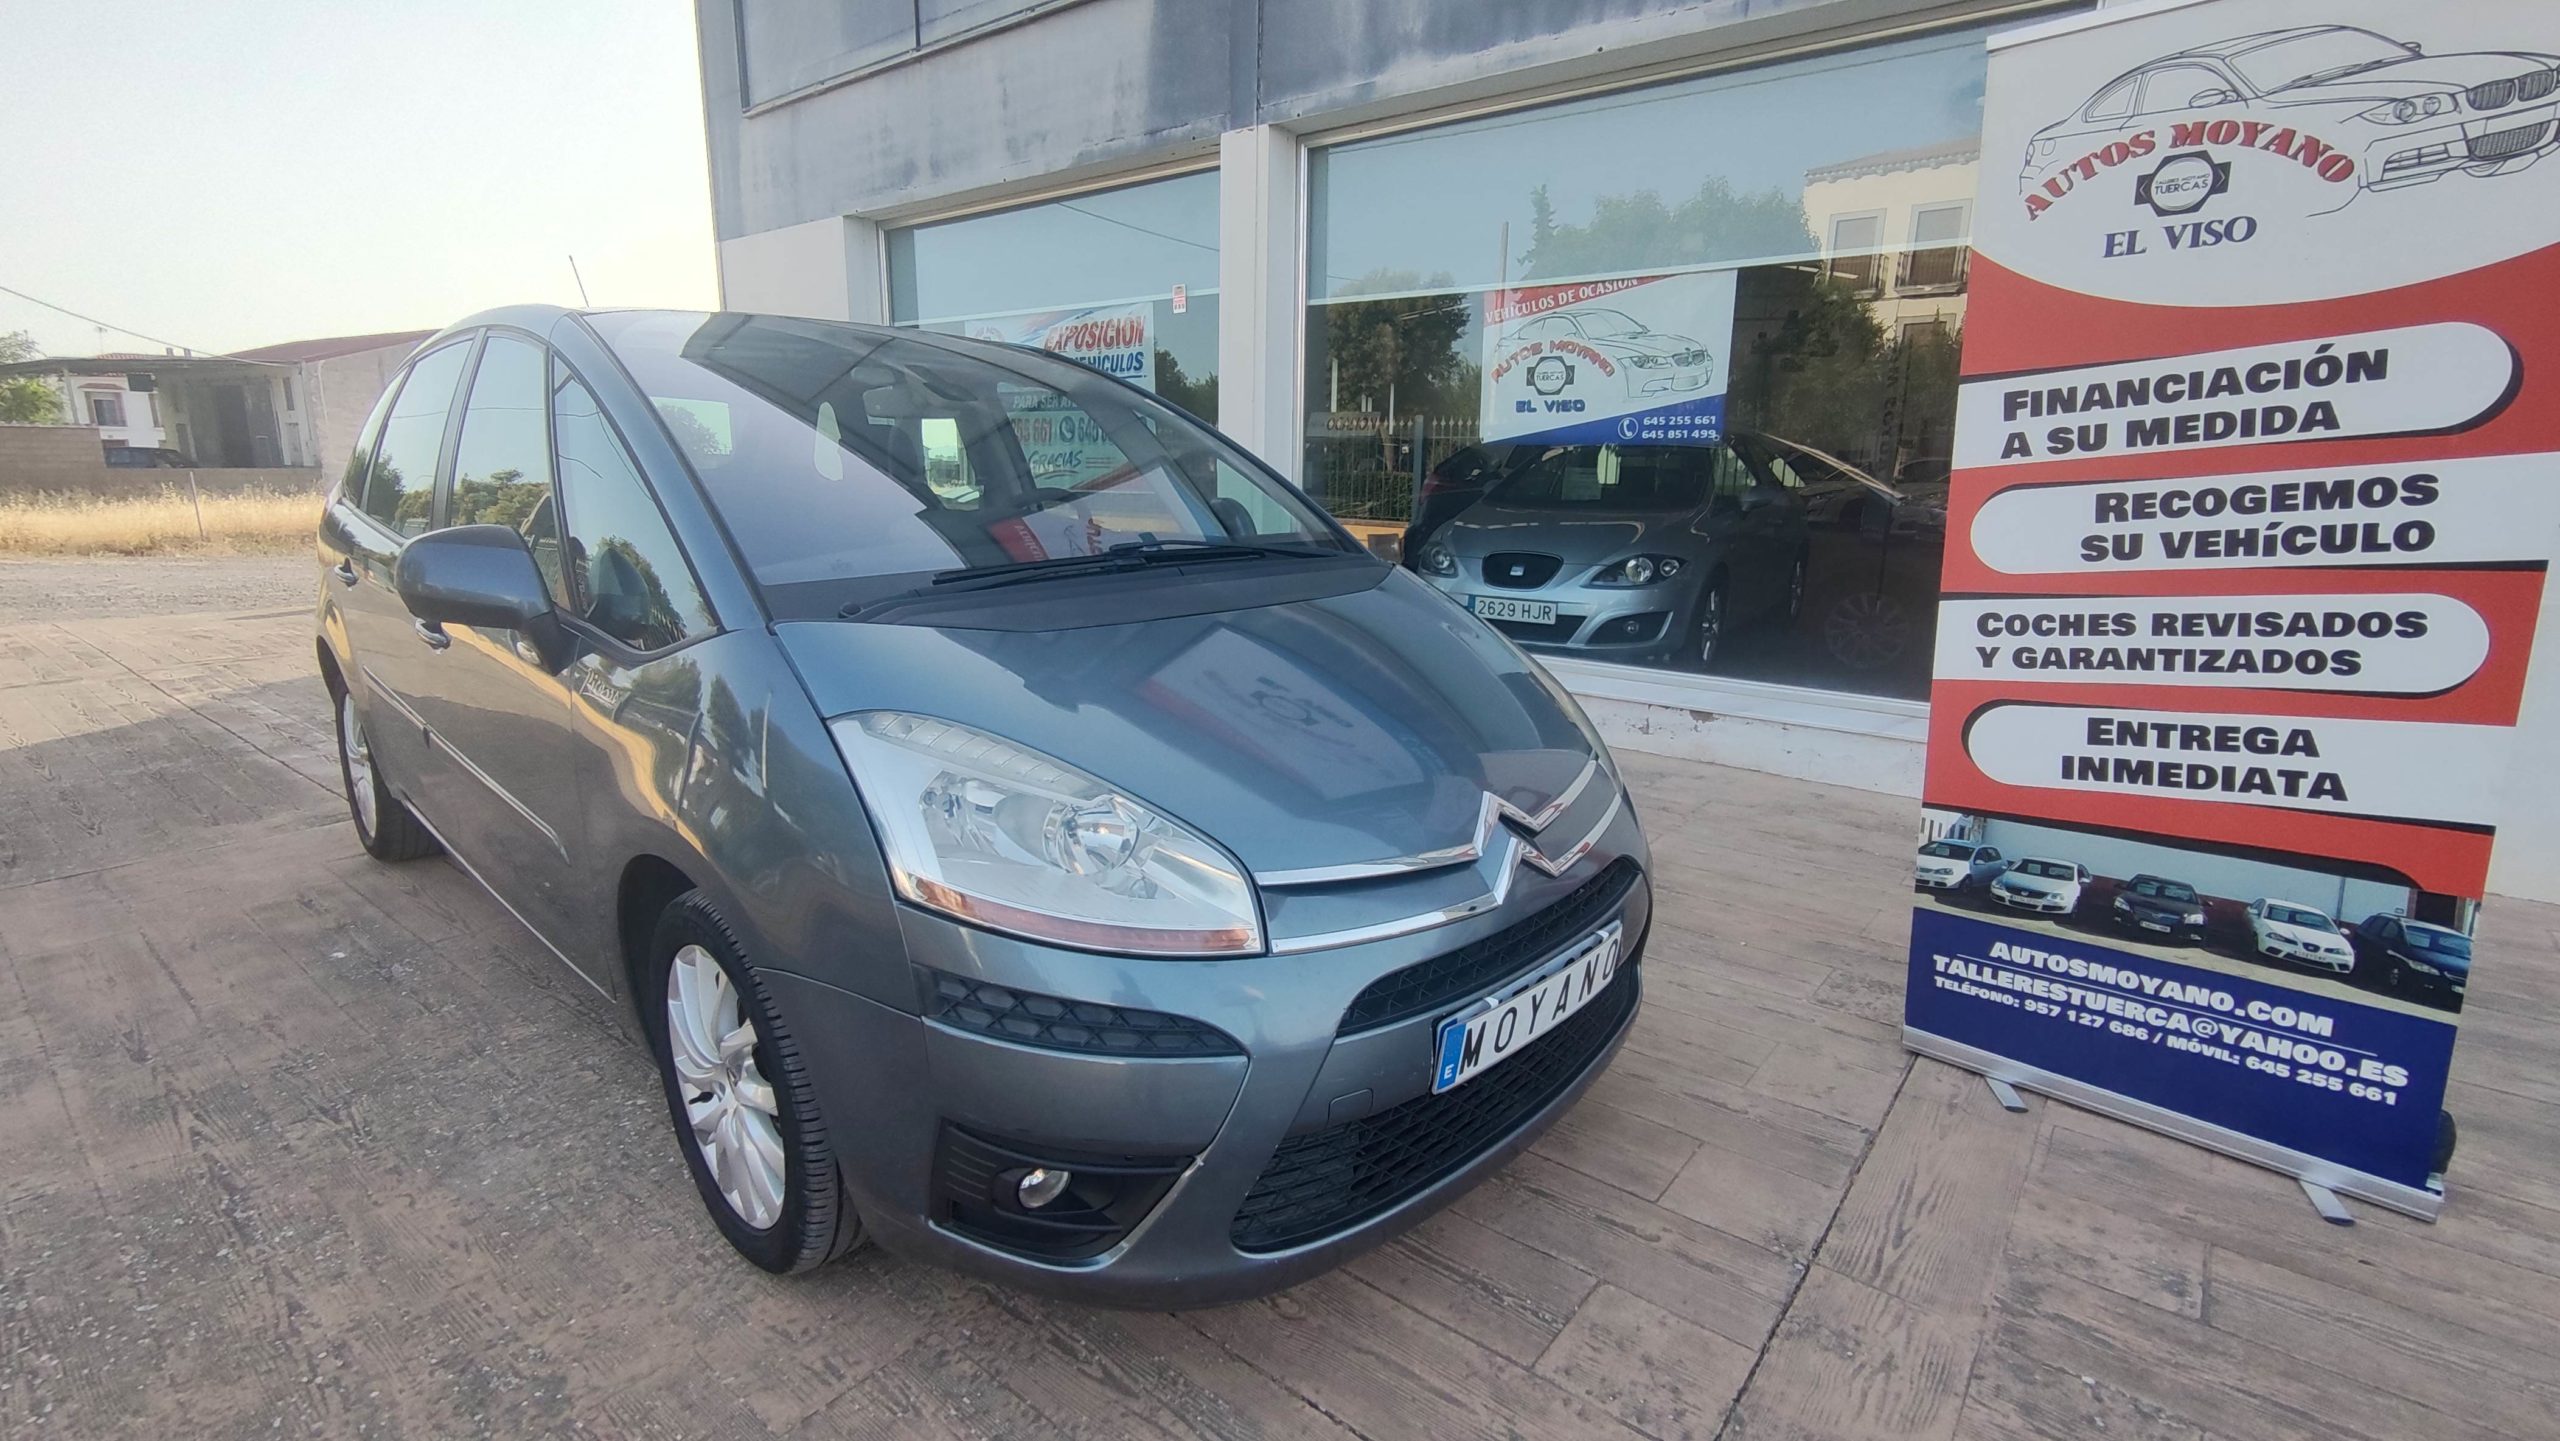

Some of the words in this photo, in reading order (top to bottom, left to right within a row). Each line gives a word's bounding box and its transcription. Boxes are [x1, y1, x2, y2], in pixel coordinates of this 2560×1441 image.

[2024, 130, 2156, 221] AUTOS
[2169, 119, 2356, 184] MOYANO
[2155, 179, 2209, 195] TUERCAS
[2103, 228, 2147, 259] EL
[2162, 215, 2257, 250] VISO
[1558, 289, 1576, 305] DE
[1491, 341, 1543, 384] AUTOS
[2003, 343, 2389, 421] FINANCIACIÓN
[1516, 400, 1537, 413] EL
[1544, 399, 1586, 413] VISO
[1643, 416, 1666, 425] 645
[1669, 416, 1691, 425] 255
[1694, 415, 1716, 425] 661
[1642, 430, 1664, 439] 645
[1667, 429, 1688, 439] 851
[1691, 429, 1716, 439] 499
[2000, 431, 2032, 459] A
[2046, 423, 2108, 456] SU
[2126, 400, 2340, 448] MEDIDA
[2094, 473, 2440, 523] RECOGEMOS
[2080, 531, 2143, 562] SU
[1478, 600, 1516, 617] 2629
[1521, 604, 1552, 620] HJR
[1976, 610, 2137, 638] COCHES
[2151, 610, 2429, 638] REVISADOS
[1976, 646, 2000, 668] Y
[2011, 647, 2363, 675] GARANTIZADOS
[2086, 717, 2321, 758] ENTREGA
[2061, 755, 2349, 801] INMEDIATA
[1458, 937, 1619, 1076] MOYANO
[1989, 941, 2334, 1037] AUTOSMOYANO.COM
[1933, 954, 2409, 1087] TALLERESTUERCA@YAHOO.ES
[1934, 976, 2020, 1008] TELÉFONO:
[2024, 999, 2061, 1017] 957
[2066, 1010, 2105, 1028] 127
[2108, 1020, 2149, 1041] 686
[2166, 1034, 2240, 1065] MÓVIL:
[2245, 1056, 2291, 1078] 645
[2295, 1069, 2343, 1091] 255
[2349, 1082, 2397, 1106] 661
[1443, 1064, 1455, 1079] E
